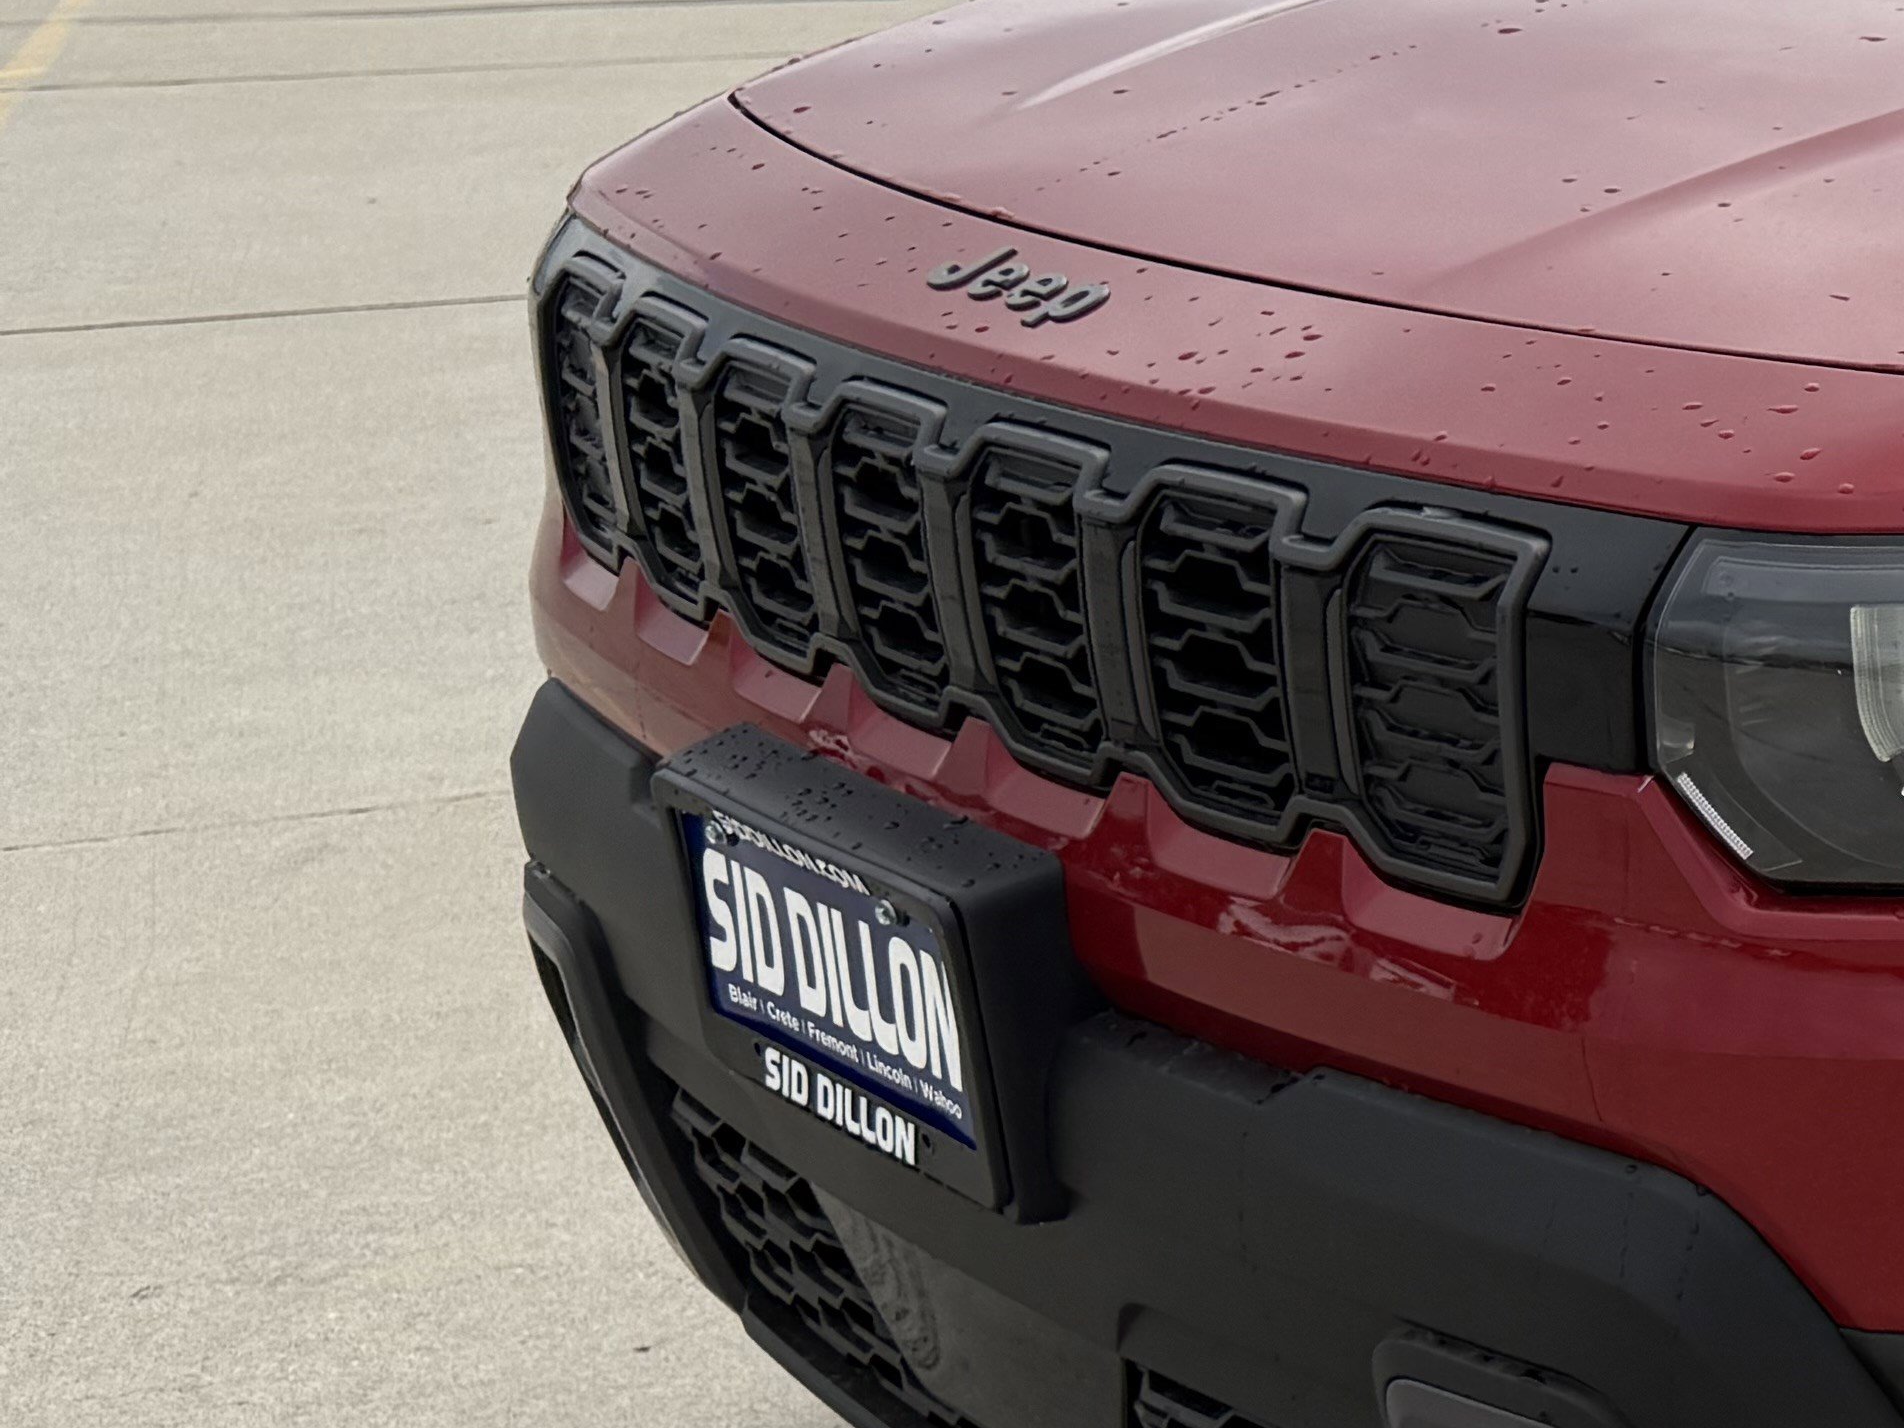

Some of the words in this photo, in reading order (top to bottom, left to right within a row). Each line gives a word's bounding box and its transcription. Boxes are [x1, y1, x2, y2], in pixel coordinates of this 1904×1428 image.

[926, 245, 1111, 329] Jeep
[703, 847, 785, 996] SID
[784, 887, 963, 1092] DILLON
[728, 983, 758, 1012] Blair
[766, 1001, 800, 1033] Crete
[807, 1020, 859, 1064] Fremont
[866, 1051, 912, 1089] Lincoln
[764, 1046, 810, 1107] SID
[816, 1080, 917, 1165] DILLON
